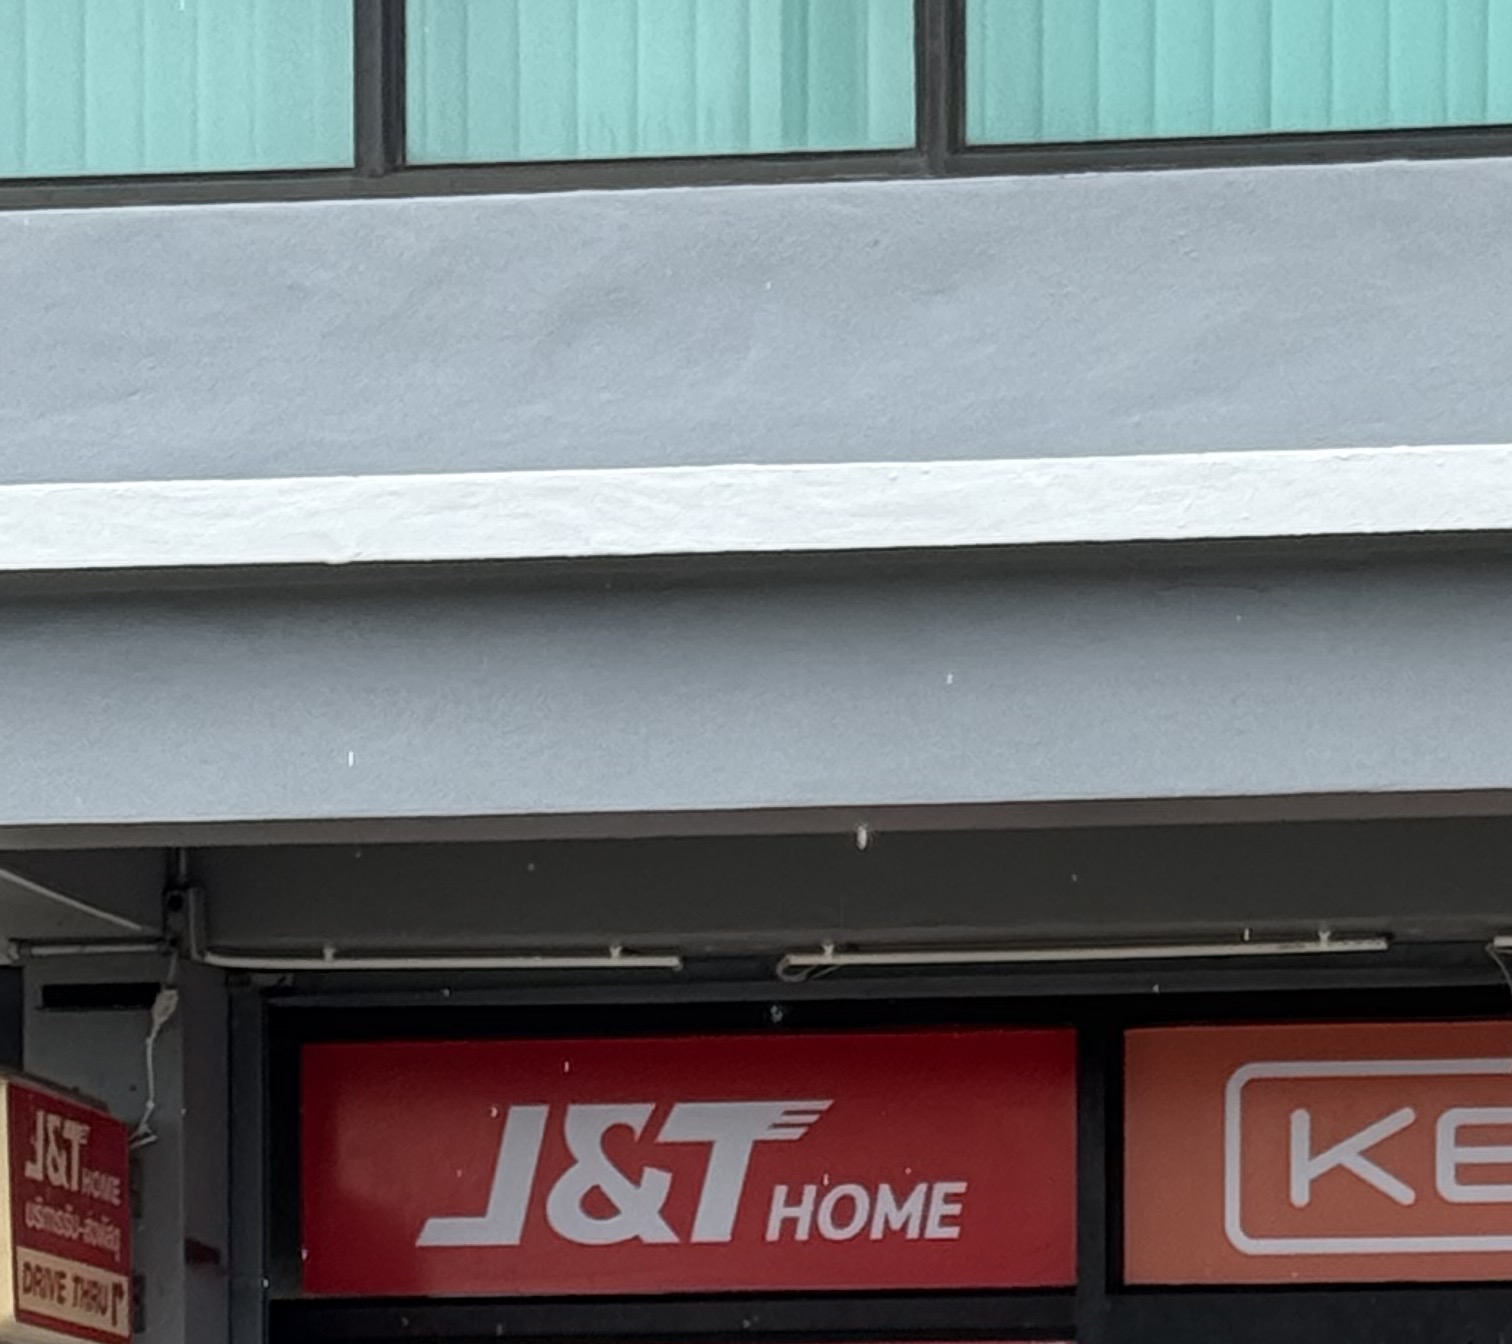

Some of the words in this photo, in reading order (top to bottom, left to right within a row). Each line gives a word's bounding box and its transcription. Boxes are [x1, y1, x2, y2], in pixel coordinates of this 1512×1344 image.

[25, 1110, 91, 1192] J&T
[82, 1169, 121, 1206] HOME
[415, 1099, 834, 1248] J&T
[765, 1181, 967, 1243] HOME
[22, 1261, 67, 1305] DRIVE
[72, 1275, 108, 1316] THRU
